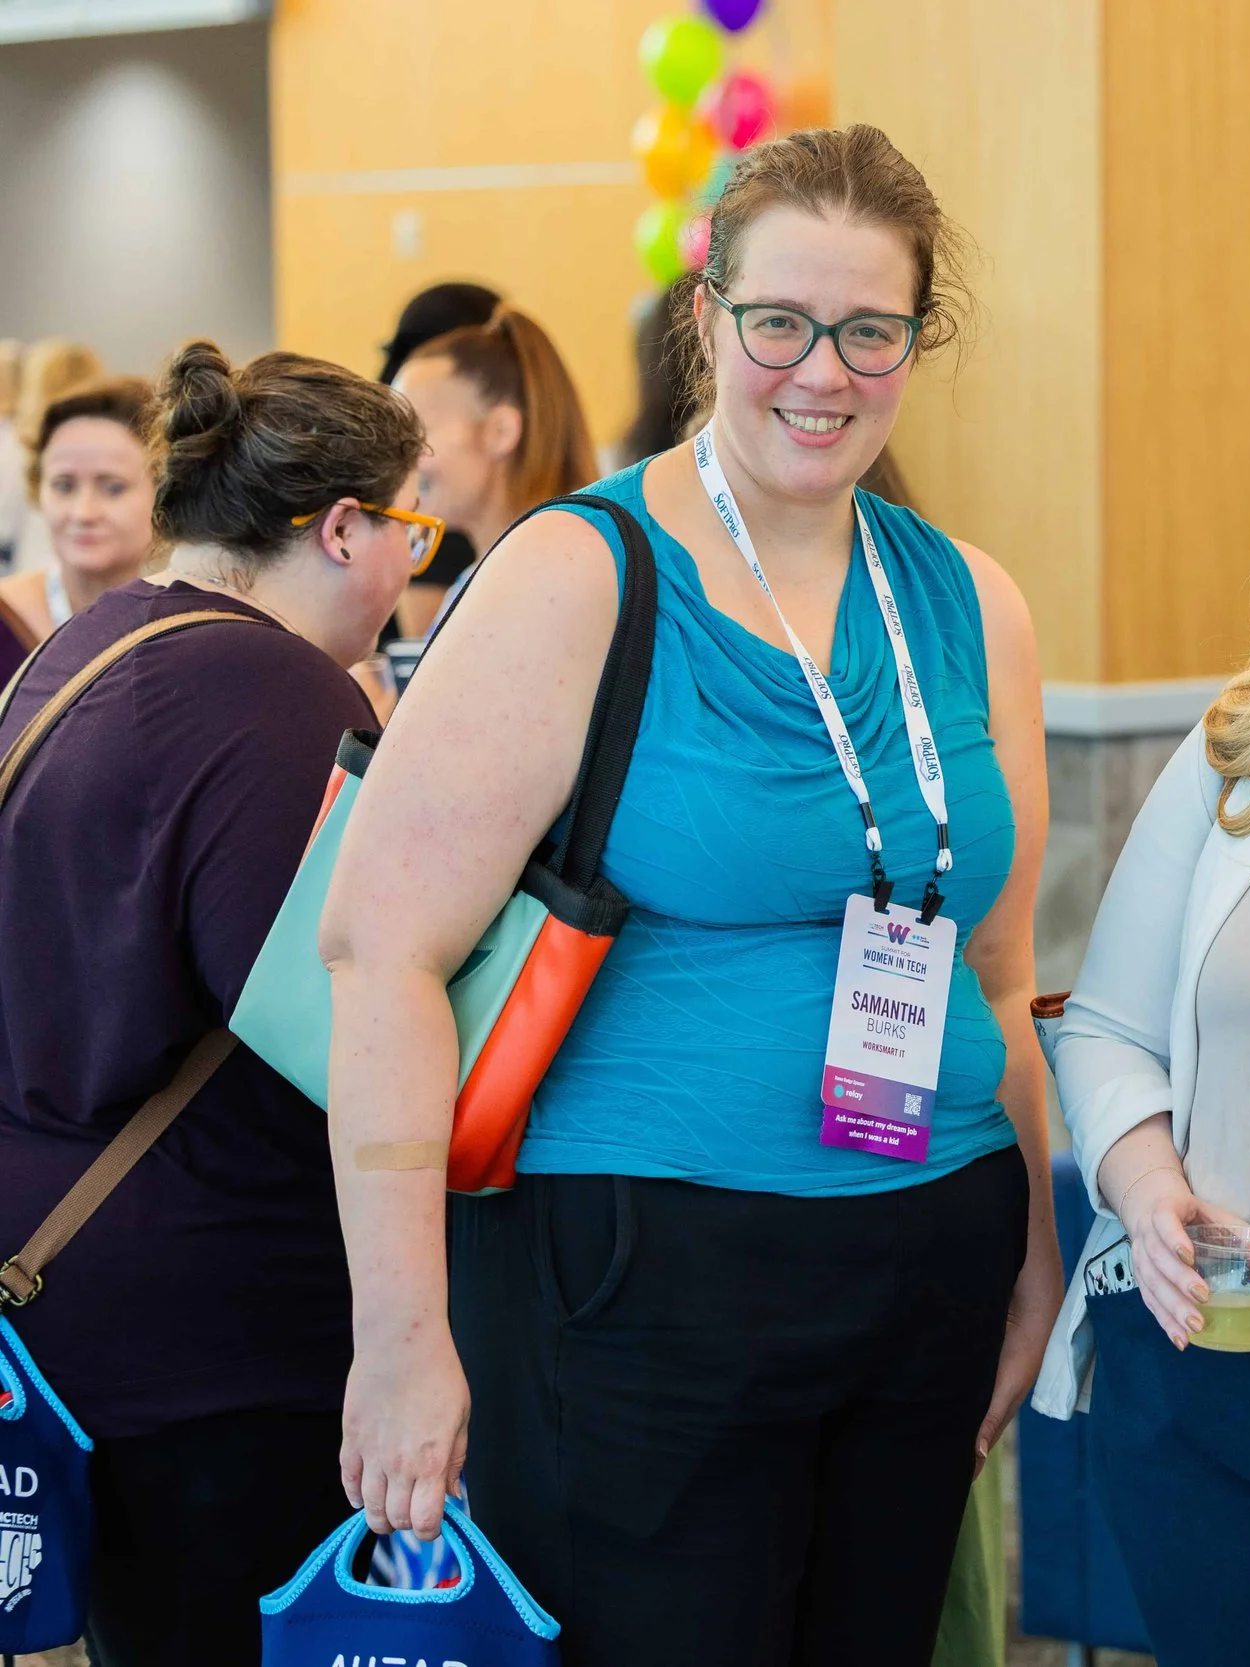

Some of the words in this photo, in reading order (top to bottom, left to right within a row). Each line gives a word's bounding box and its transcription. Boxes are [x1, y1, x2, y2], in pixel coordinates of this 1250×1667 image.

[863, 948, 894, 966] WOMEN
[895, 957, 905, 969] IN
[907, 959, 927, 975] TECH
[851, 990, 925, 1027] SAMANTHA
[867, 1017, 906, 1040] BURKS
[862, 1041, 898, 1056] WORKSMART
[899, 1050, 905, 1058] IT
[846, 1089, 863, 1101] relay
[835, 1114, 846, 1123] Ask
[857, 1117, 874, 1127] about
[875, 1121, 886, 1131] my
[886, 1123, 906, 1134] dream
[906, 1127, 918, 1136] job
[848, 1130, 864, 1139] when
[868, 1134, 882, 1142] was
[888, 1136, 900, 1146] kid
